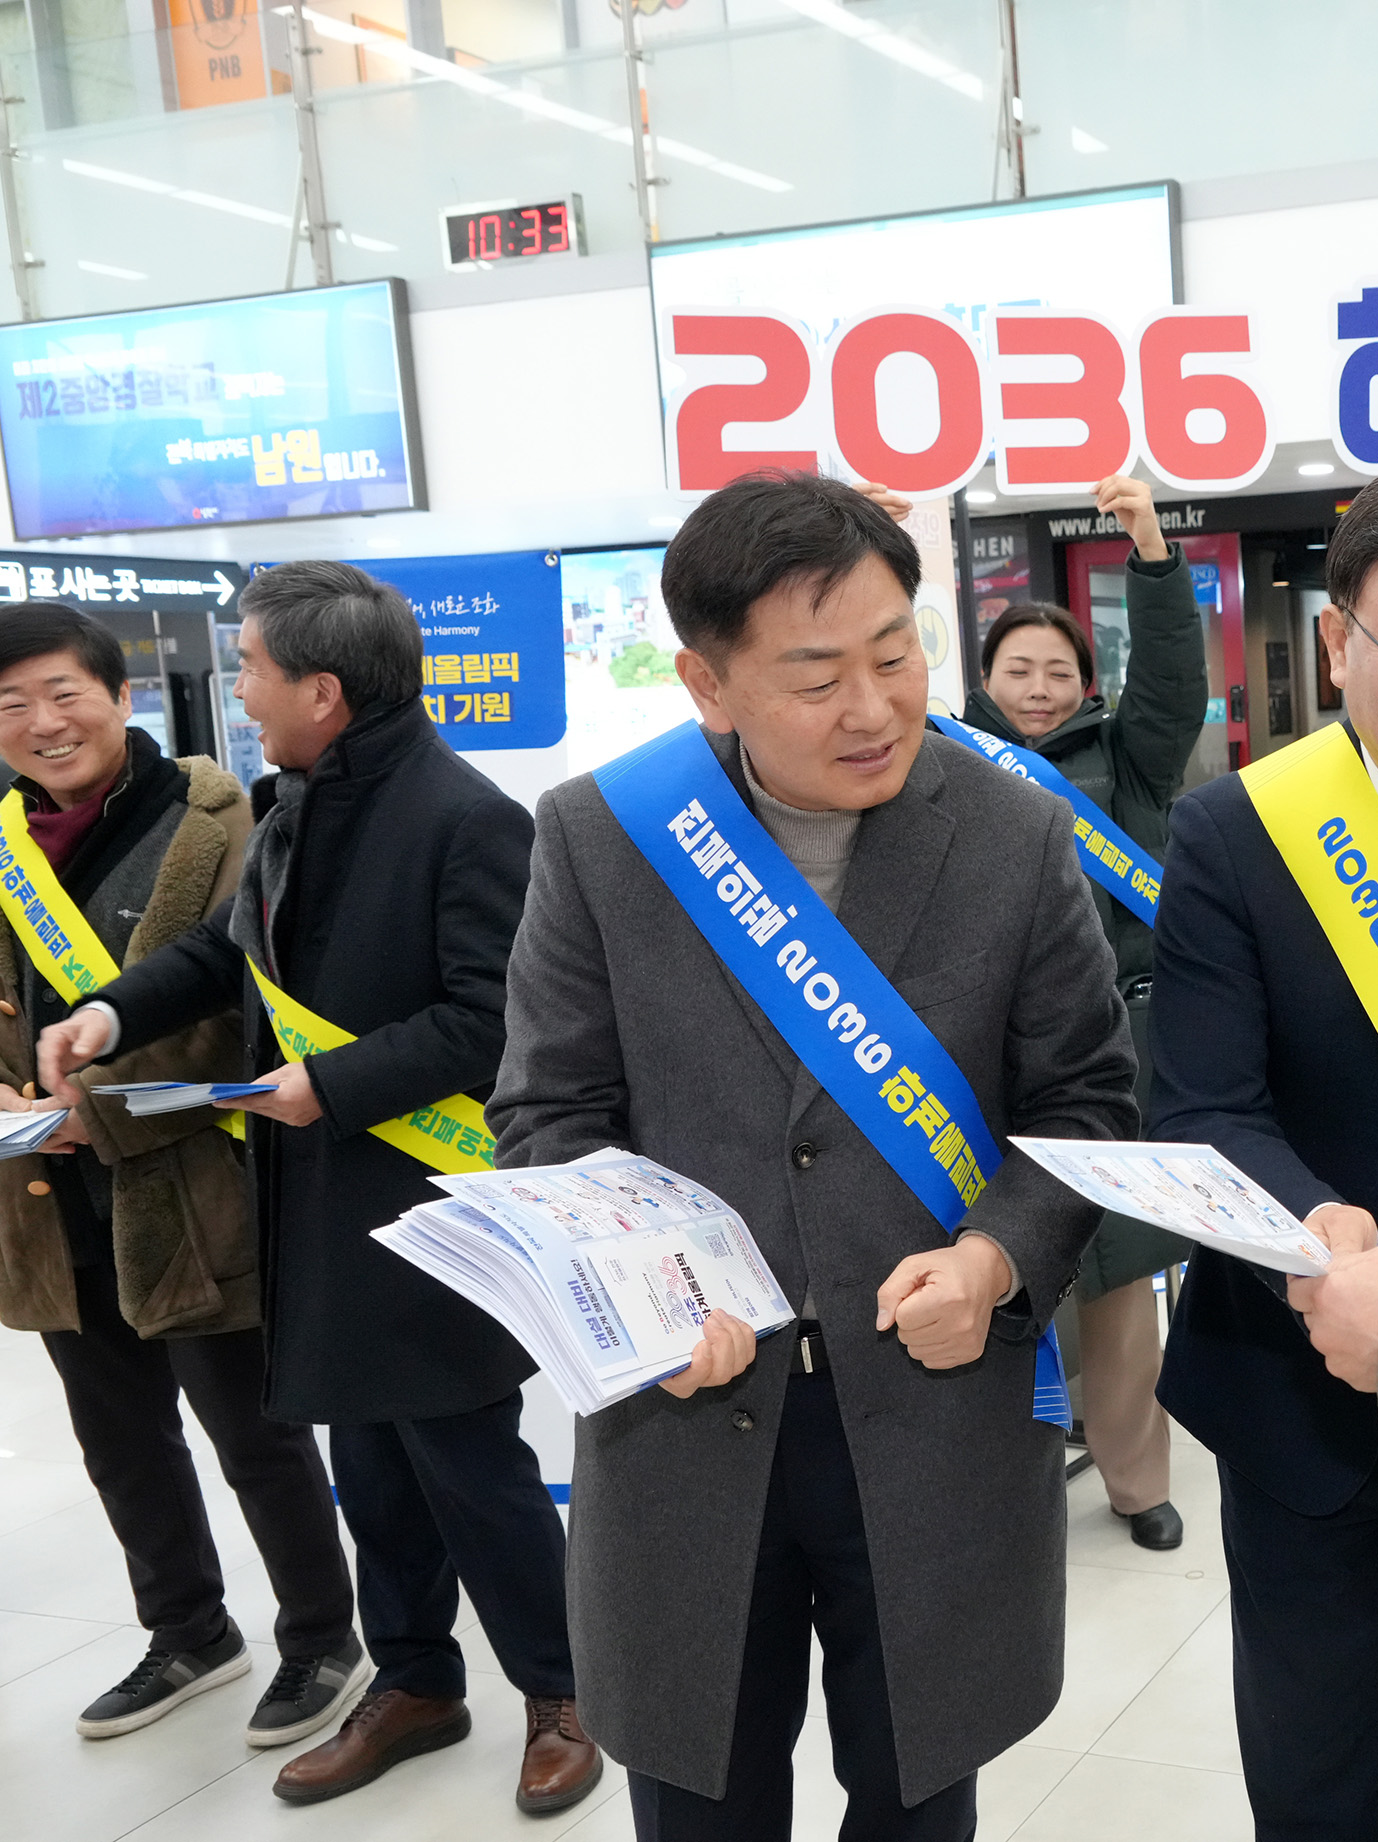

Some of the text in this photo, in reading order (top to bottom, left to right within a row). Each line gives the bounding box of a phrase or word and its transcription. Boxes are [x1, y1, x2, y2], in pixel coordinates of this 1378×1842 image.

[208, 57, 242, 81] PNB
[466, 204, 569, 260] 10:33
[672, 313, 1267, 492] 2036
[1048, 504, 1206, 537] www.deuen.kr
[29, 567, 60, 597] 표
[60, 566, 112, 601] 사는
[113, 569, 140, 602] 곳
[430, 594, 470, 617] 새로운
[471, 591, 500, 616] 조화
[433, 625, 480, 637] Harmony
[422, 652, 519, 685] 올림픽
[422, 691, 511, 724] 치 기원
[1073, 814, 1133, 879] 계올림픽
[1, 864, 73, 960] 하계올림픽
[666, 798, 988, 1208] 전북의꿈, 2036 하계올림픽
[569, 1257, 603, 1313] 행동하세요!
[657, 1256, 693, 1330] 2036
[566, 1277, 611, 1350] 대설 대비
[682, 1295, 705, 1327] 전주
[598, 1314, 621, 1347] 이렇게
